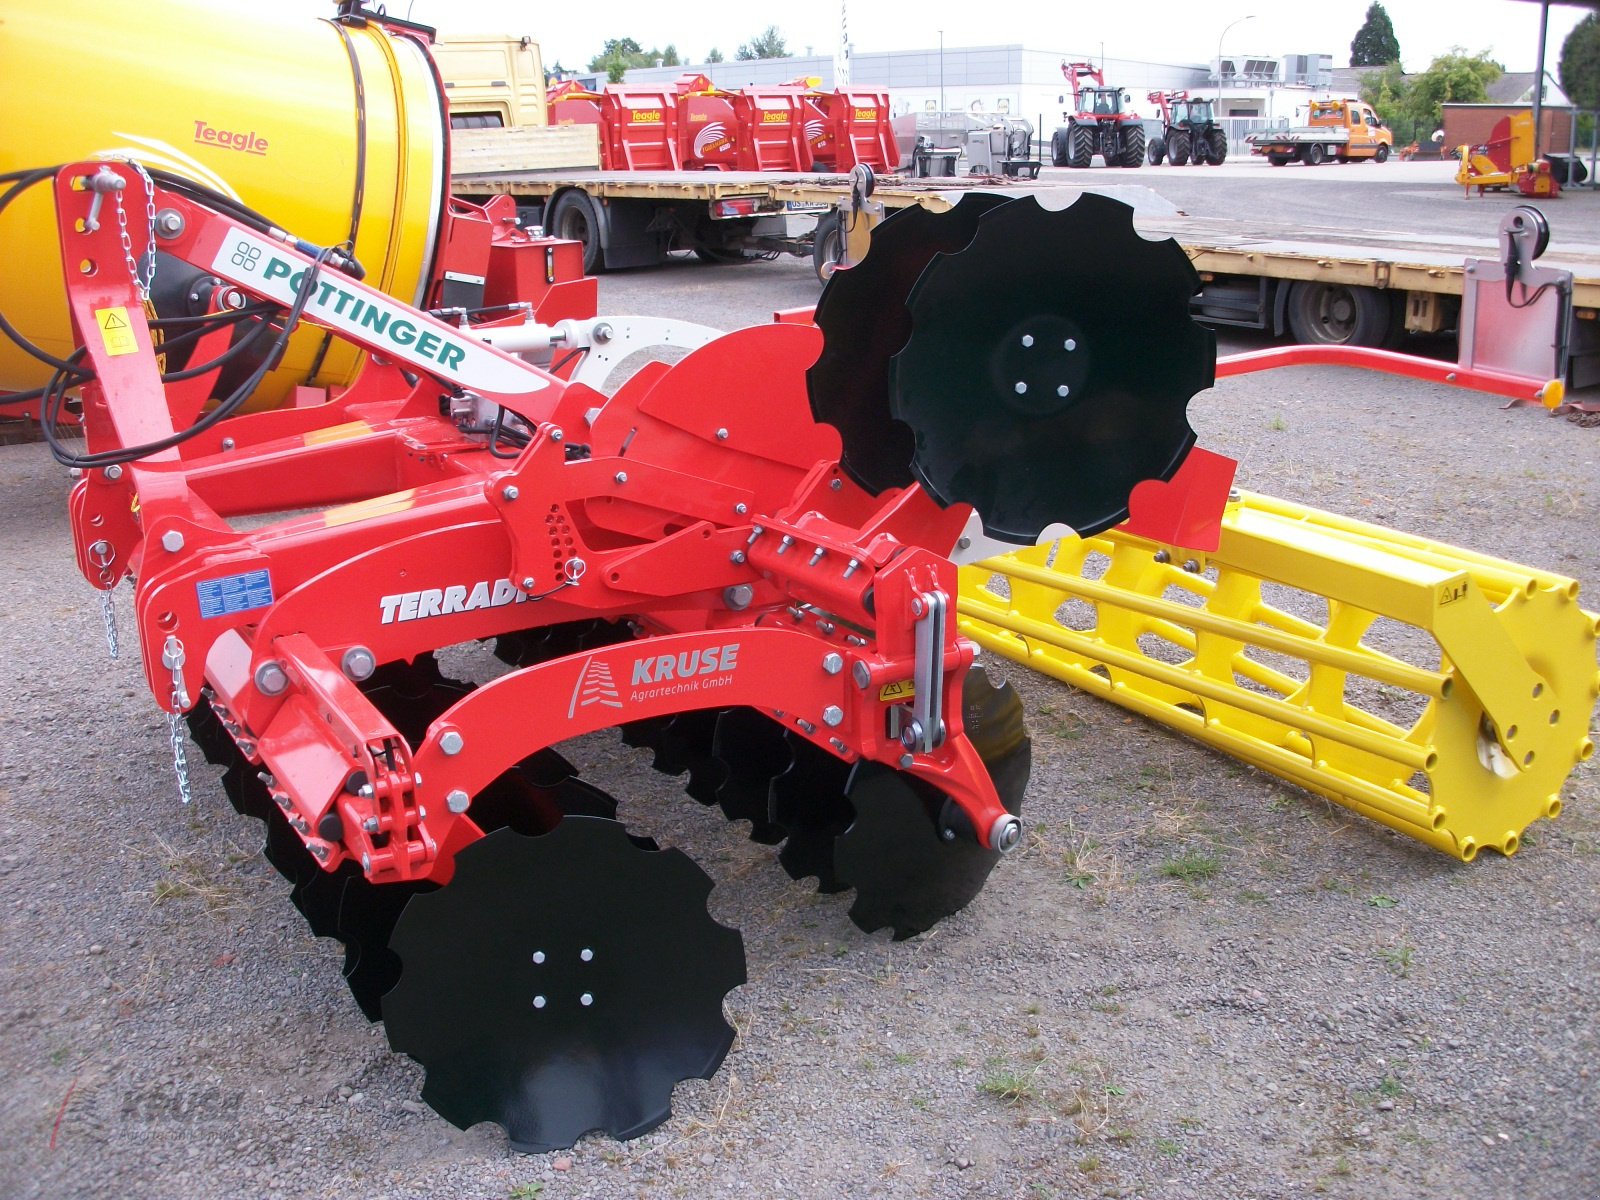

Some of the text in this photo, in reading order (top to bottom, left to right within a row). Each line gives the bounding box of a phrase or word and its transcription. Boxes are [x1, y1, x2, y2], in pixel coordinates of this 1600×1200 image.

[632, 110, 660, 122] Teagle
[763, 110, 787, 122] Teagle
[855, 108, 877, 120] Teagle
[194, 120, 269, 153] Teagle
[631, 643, 741, 686] KRUSE
[630, 674, 733, 703] Agrartechnik GmbH
